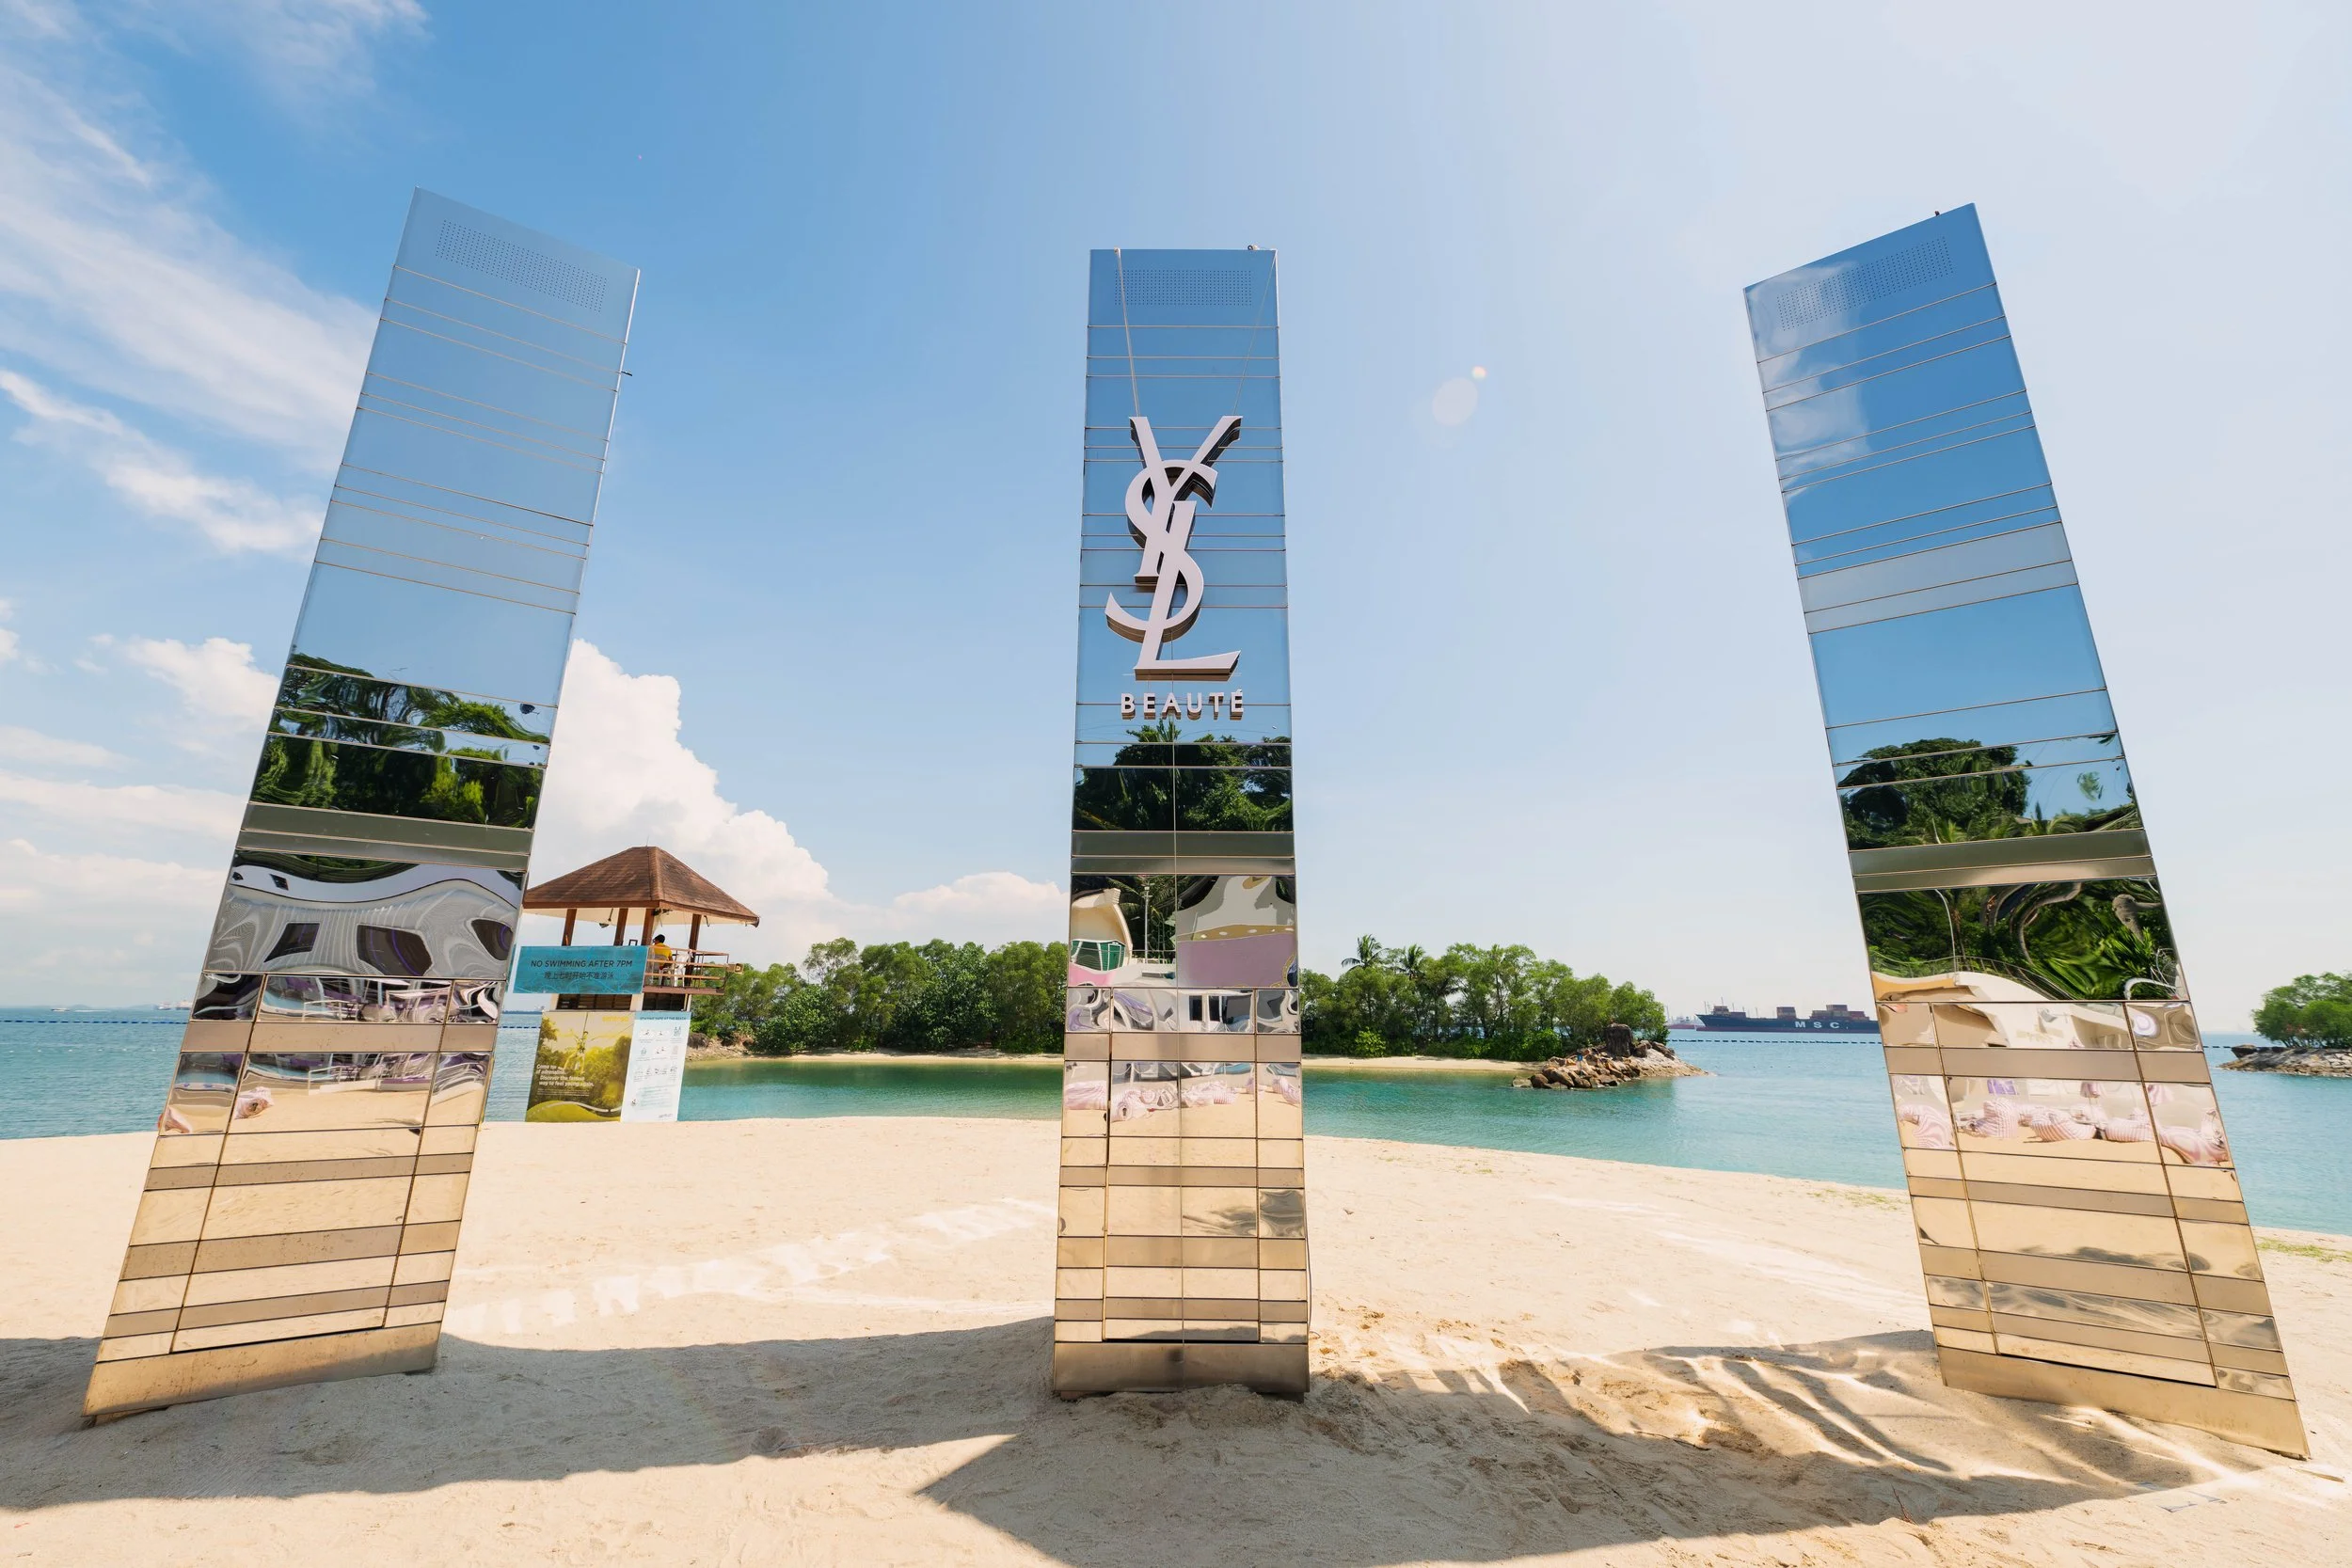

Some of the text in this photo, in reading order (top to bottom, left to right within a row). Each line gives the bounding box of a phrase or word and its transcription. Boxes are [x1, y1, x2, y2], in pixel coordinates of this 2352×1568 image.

[1120, 689, 1244, 719] BEAUTÉ
[531, 959, 632, 968] NO SWIMMING AFTER 7PM
